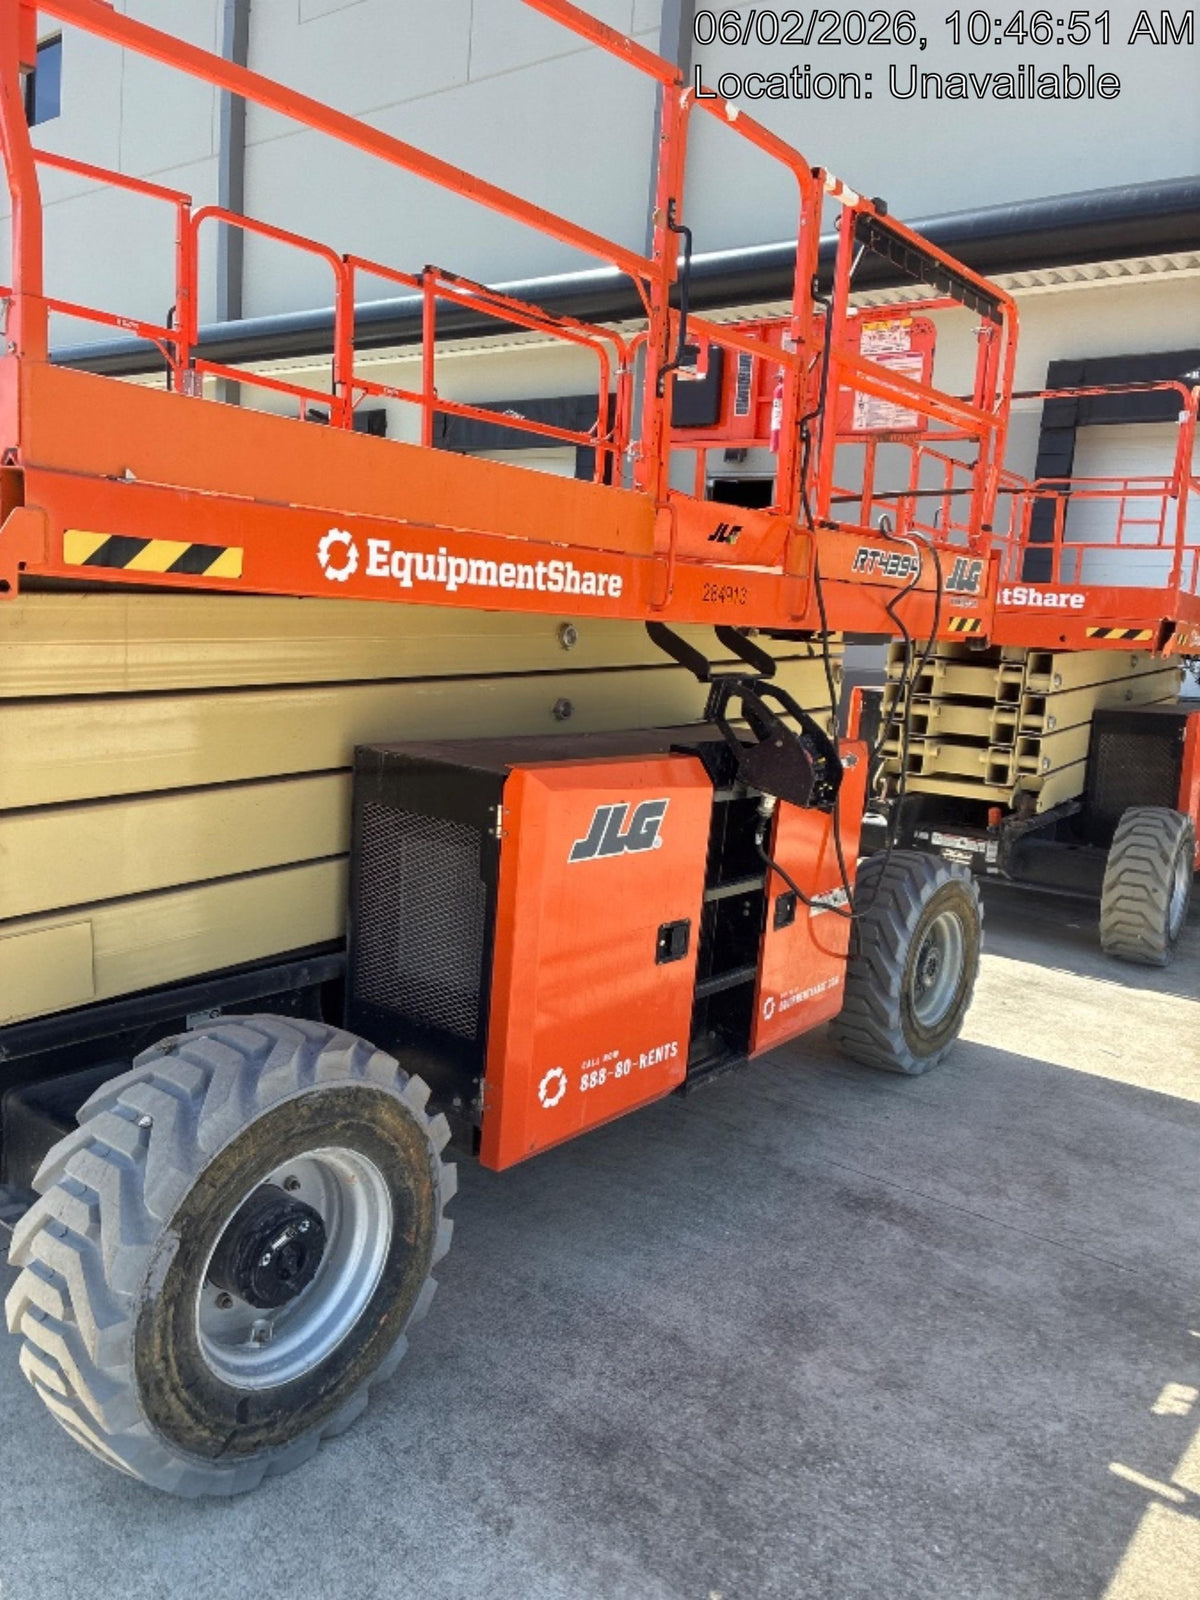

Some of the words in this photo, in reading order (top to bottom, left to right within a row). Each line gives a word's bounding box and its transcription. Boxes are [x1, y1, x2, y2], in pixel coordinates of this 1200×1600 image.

[366, 538, 623, 597] EquipmentShare
[944, 556, 983, 593] JLG
[702, 583, 748, 605] 284913
[567, 798, 670, 864] JLG
[580, 1041, 678, 1093] 888-80-RENTS
